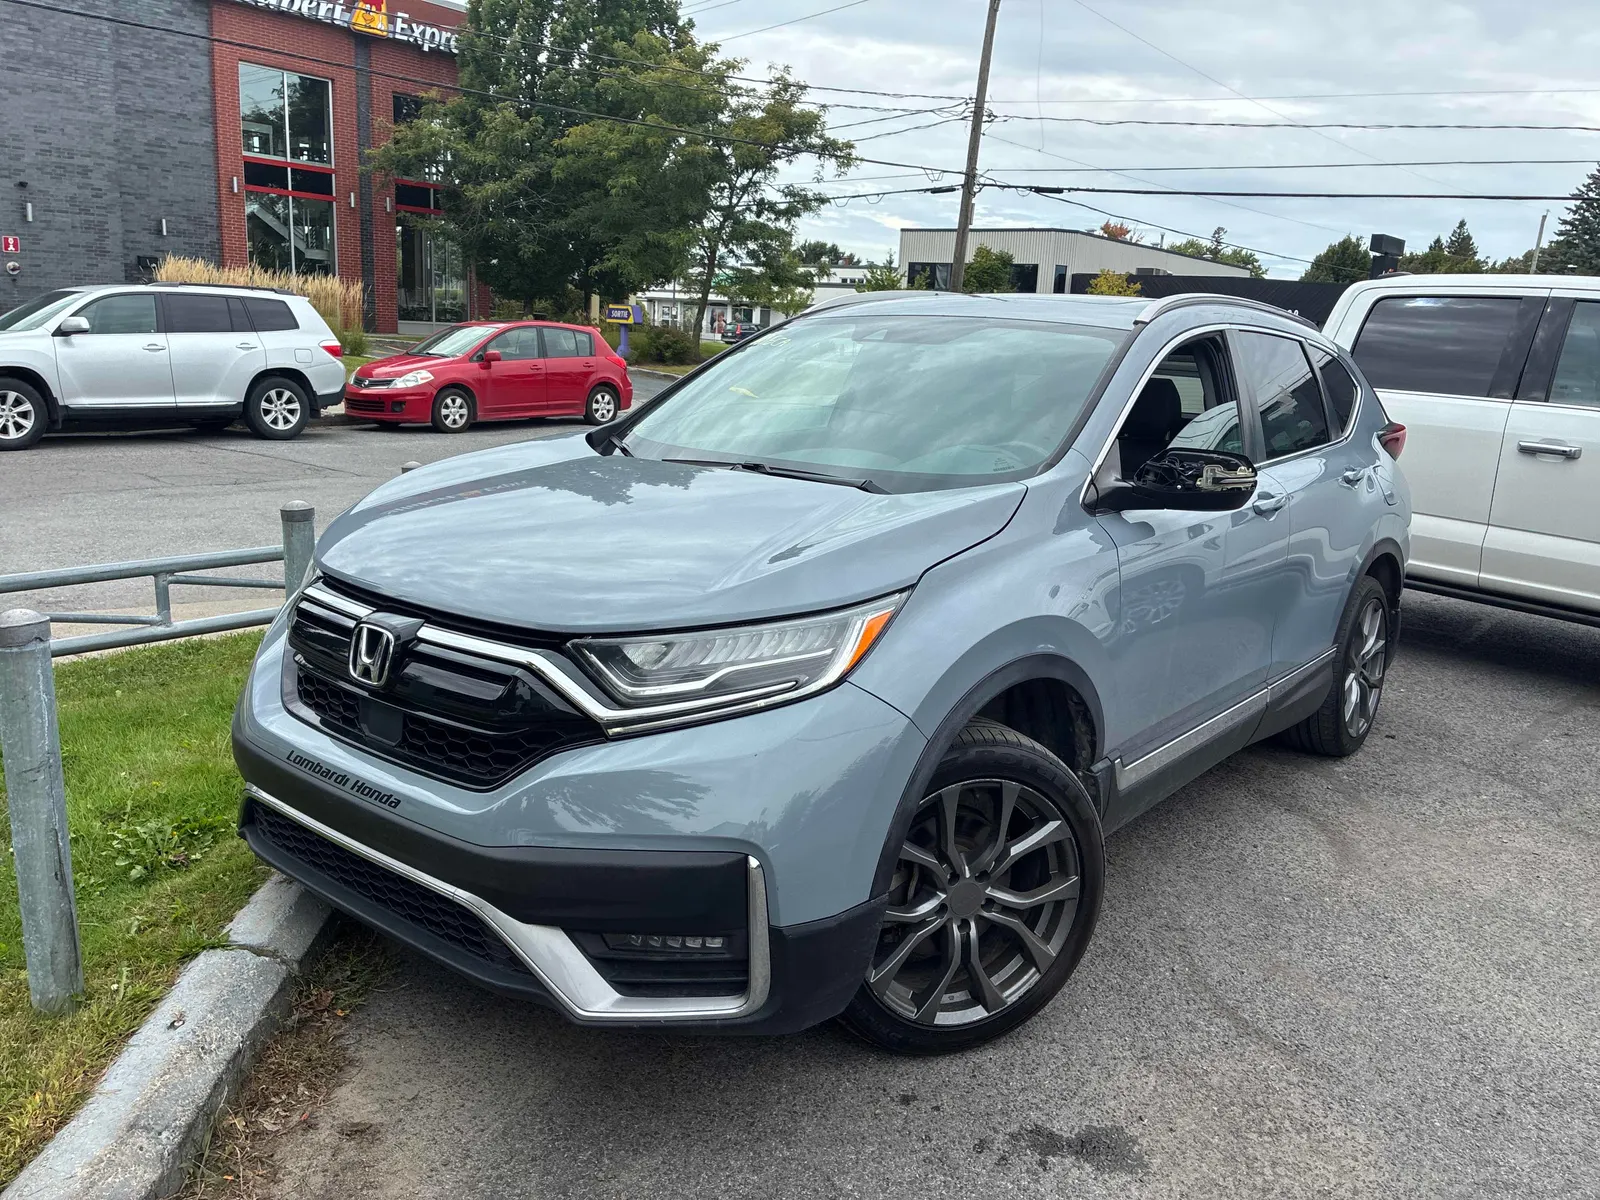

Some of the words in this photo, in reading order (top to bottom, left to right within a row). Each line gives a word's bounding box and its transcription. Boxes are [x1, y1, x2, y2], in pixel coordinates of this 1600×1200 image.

[611, 310, 628, 318] SORTIE
[286, 750, 350, 787] Lombardi
[350, 779, 402, 809] Honda
